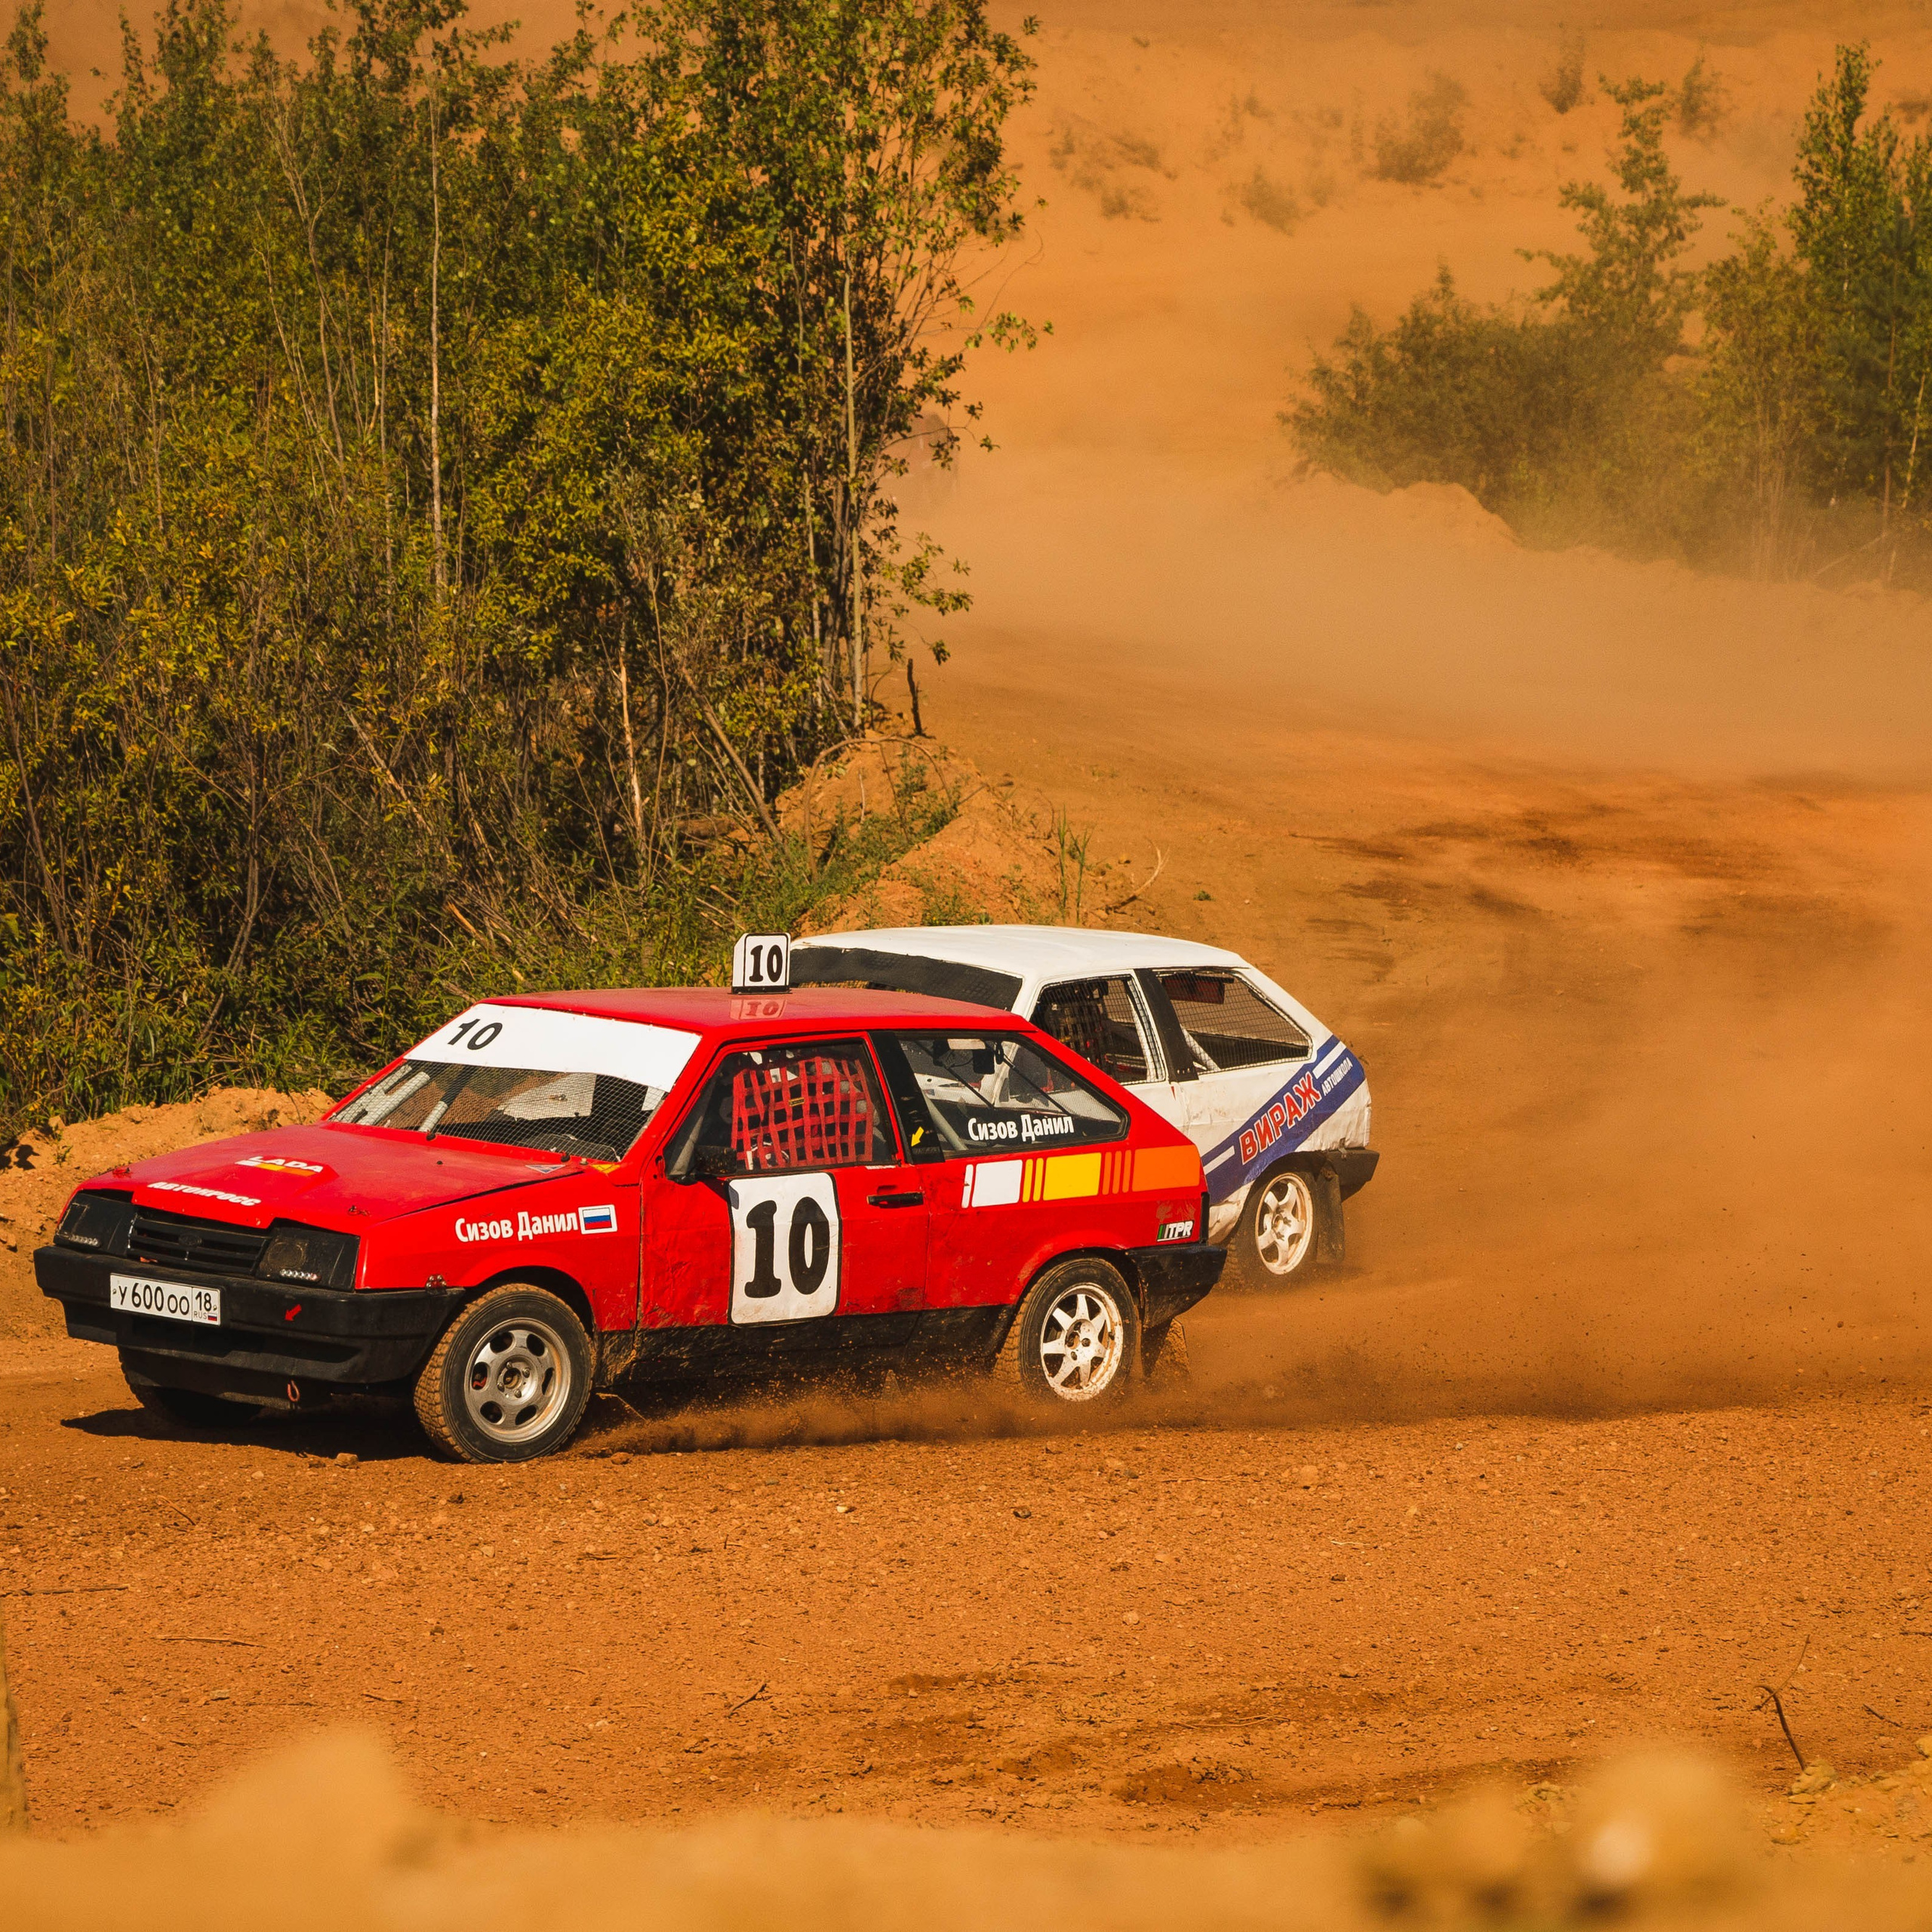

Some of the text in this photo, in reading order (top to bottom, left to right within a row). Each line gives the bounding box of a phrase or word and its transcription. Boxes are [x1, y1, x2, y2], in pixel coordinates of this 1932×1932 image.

[749, 944, 783, 983] 10
[448, 1019, 503, 1050] 10
[1321, 1057, 1353, 1097] АВТОШКОЛА
[968, 1114, 1074, 1142] Сизов Данил
[1239, 1072, 1321, 1164] ВИРАЖ
[249, 1156, 323, 1173] LADA
[147, 1181, 261, 1206] АВТОКРОСС
[455, 1211, 578, 1242] Сизов Данил
[744, 1196, 830, 1298] 10
[193, 1310, 208, 1320] RUS
